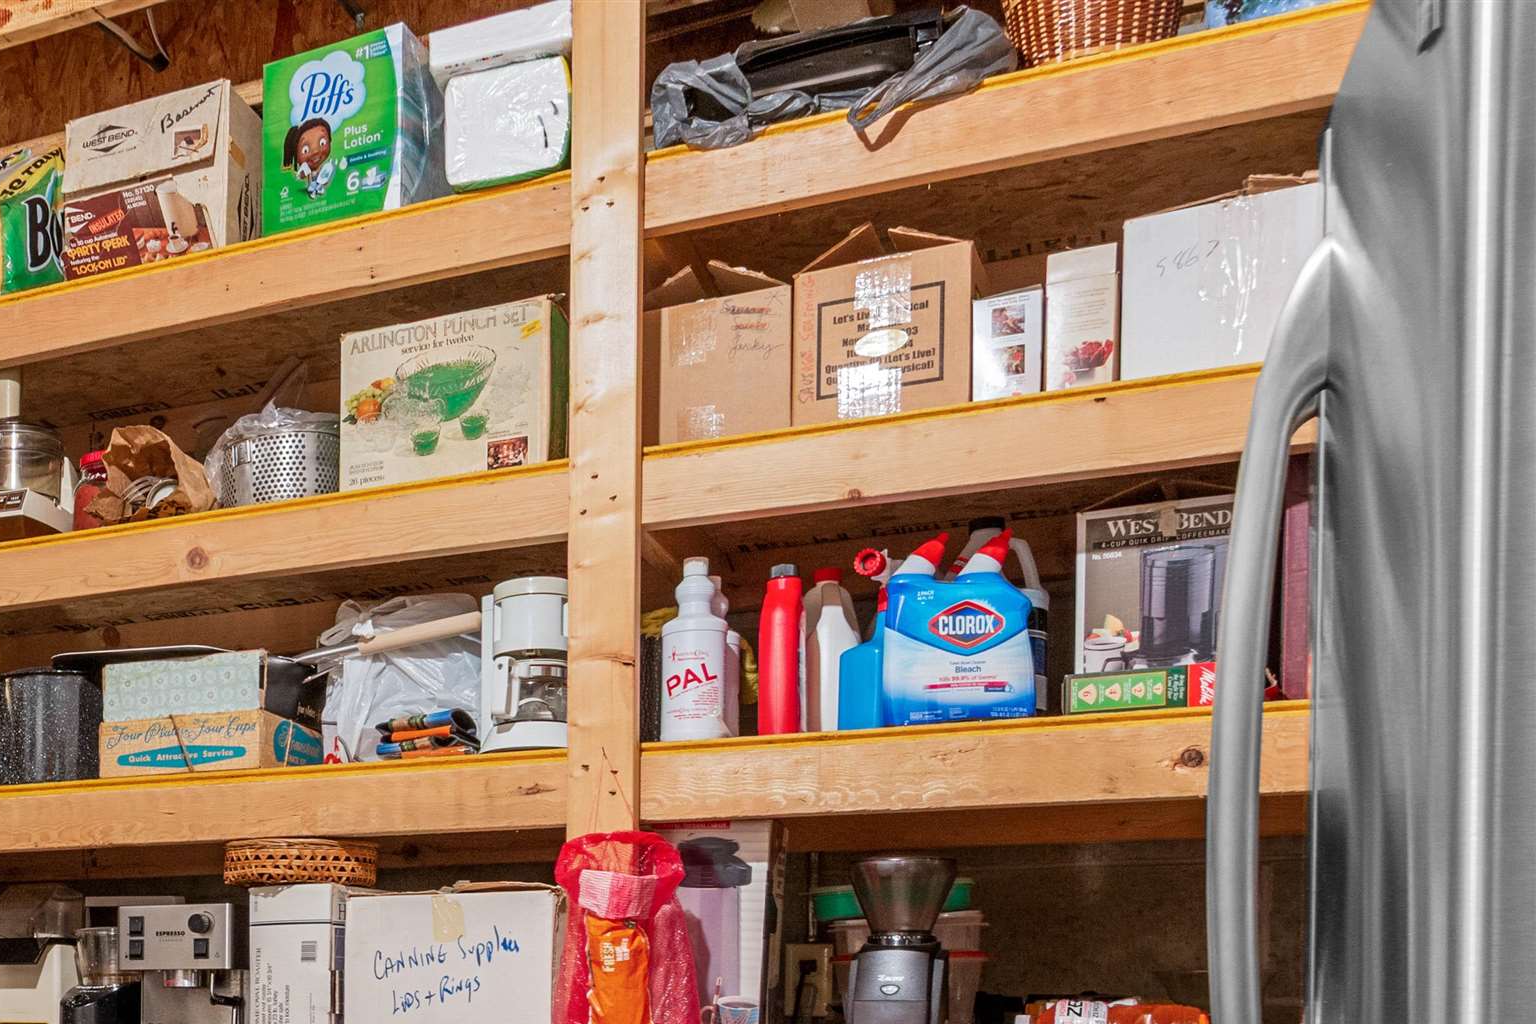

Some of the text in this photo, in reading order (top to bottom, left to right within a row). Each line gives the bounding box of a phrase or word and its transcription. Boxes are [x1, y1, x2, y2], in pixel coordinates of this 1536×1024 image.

[355, 45, 369, 59] #1
[300, 72, 354, 122] Puffs
[82, 128, 135, 148] WEST BEND
[343, 124, 368, 137] Plus
[344, 132, 381, 149] Lotion
[346, 171, 360, 192] 6
[127, 201, 147, 209] ALMOND
[71, 212, 93, 223] BEND
[88, 209, 125, 235] INSULATED
[67, 235, 130, 259] PARTY PERK
[833, 314, 855, 325] Let's
[349, 305, 528, 355] ARLINGTON PUNCH SET
[401, 333, 474, 354] service for twelve
[1176, 511, 1231, 530] BEND
[1101, 540, 1125, 549] 4-CUP
[1128, 538, 1148, 546] QUIK
[938, 615, 995, 636] CLOROX
[955, 665, 982, 674] Bleach
[667, 663, 717, 696] PAL
[106, 726, 143, 750] Four
[226, 716, 257, 738] Cups
[128, 749, 234, 763] Quick Attractive Service
